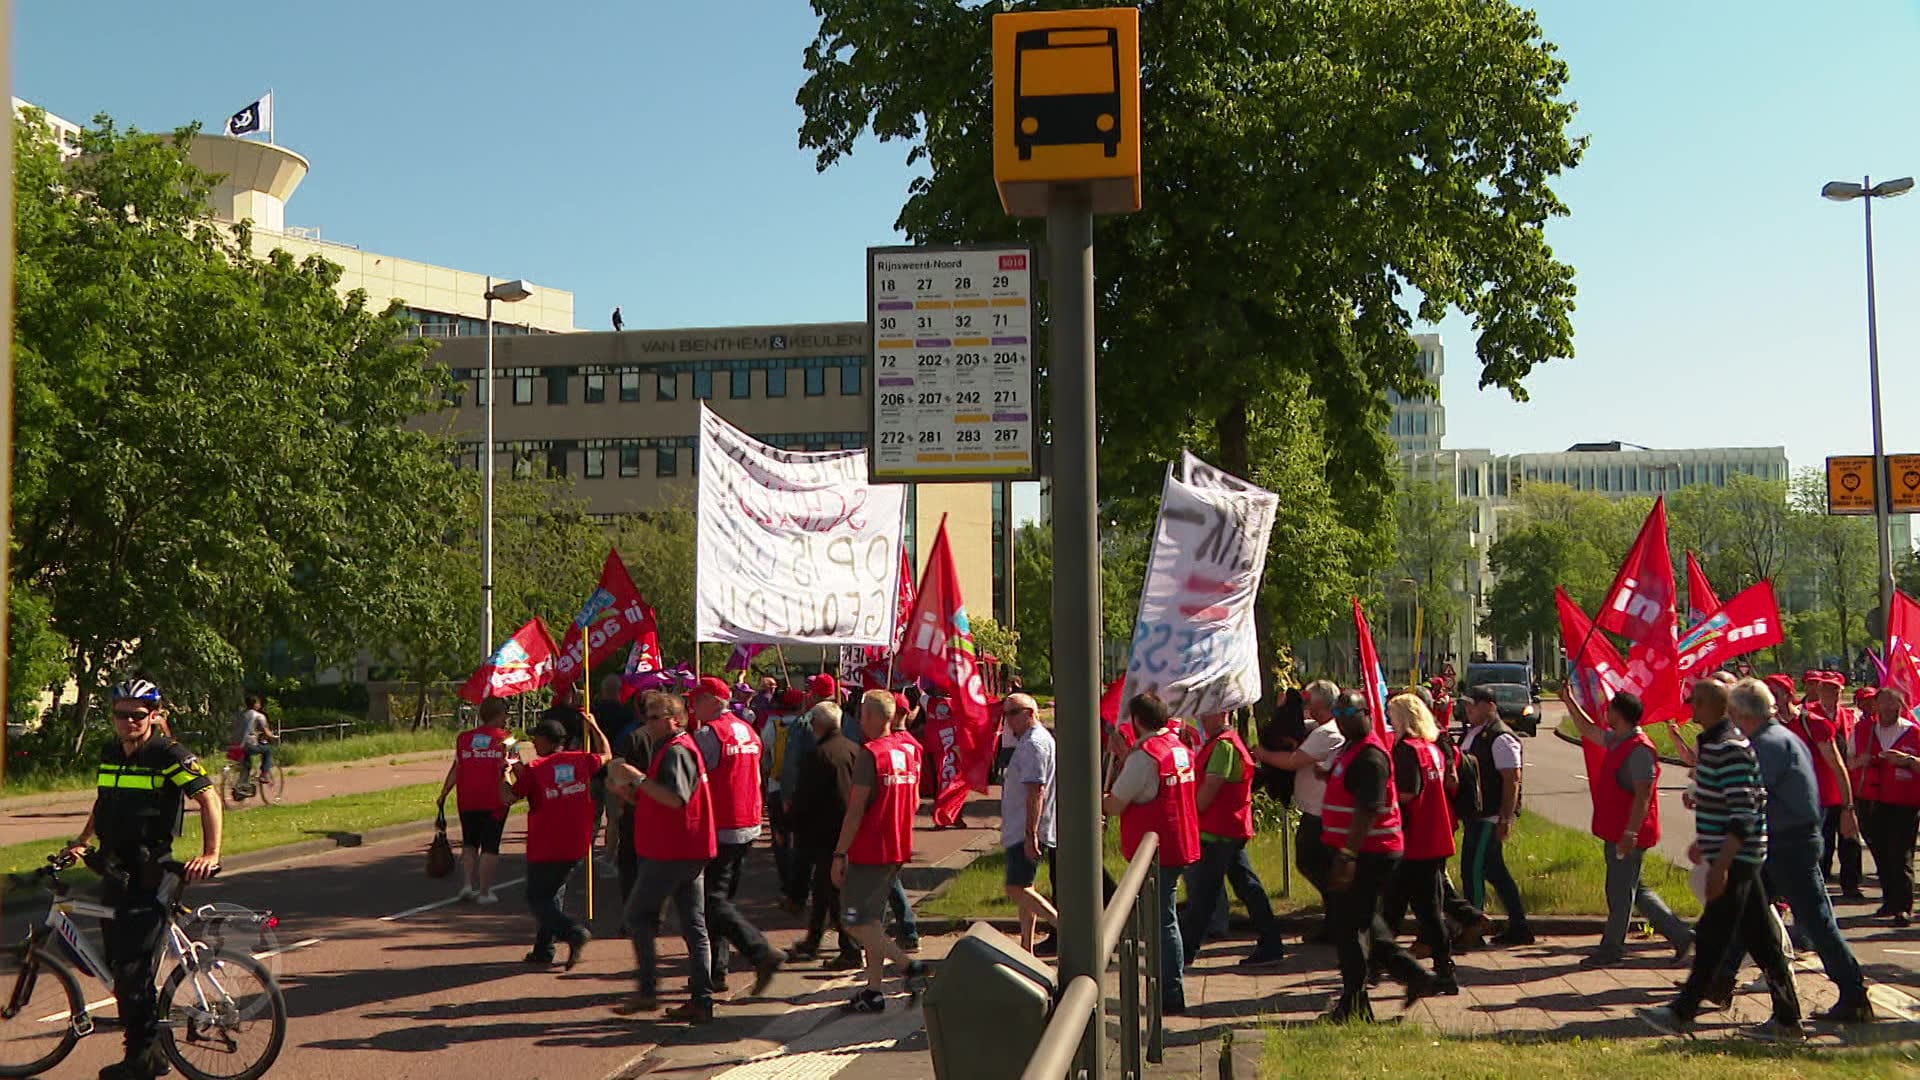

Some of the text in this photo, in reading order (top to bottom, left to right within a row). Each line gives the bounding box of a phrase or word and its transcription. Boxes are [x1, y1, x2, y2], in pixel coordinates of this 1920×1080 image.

[881, 280, 896, 292] 18
[917, 279, 933, 290] 27
[880, 314, 1008, 330] 30 31 32 71
[641, 340, 675, 353] VAN
[680, 337, 768, 353] BENTHEM
[790, 334, 863, 348] KEULEN
[880, 352, 1018, 367] 72 202 203 204
[918, 393, 942, 404] 207
[957, 392, 980, 404] 242
[994, 391, 1017, 402] 271
[881, 430, 1018, 443] 272 281 283 287
